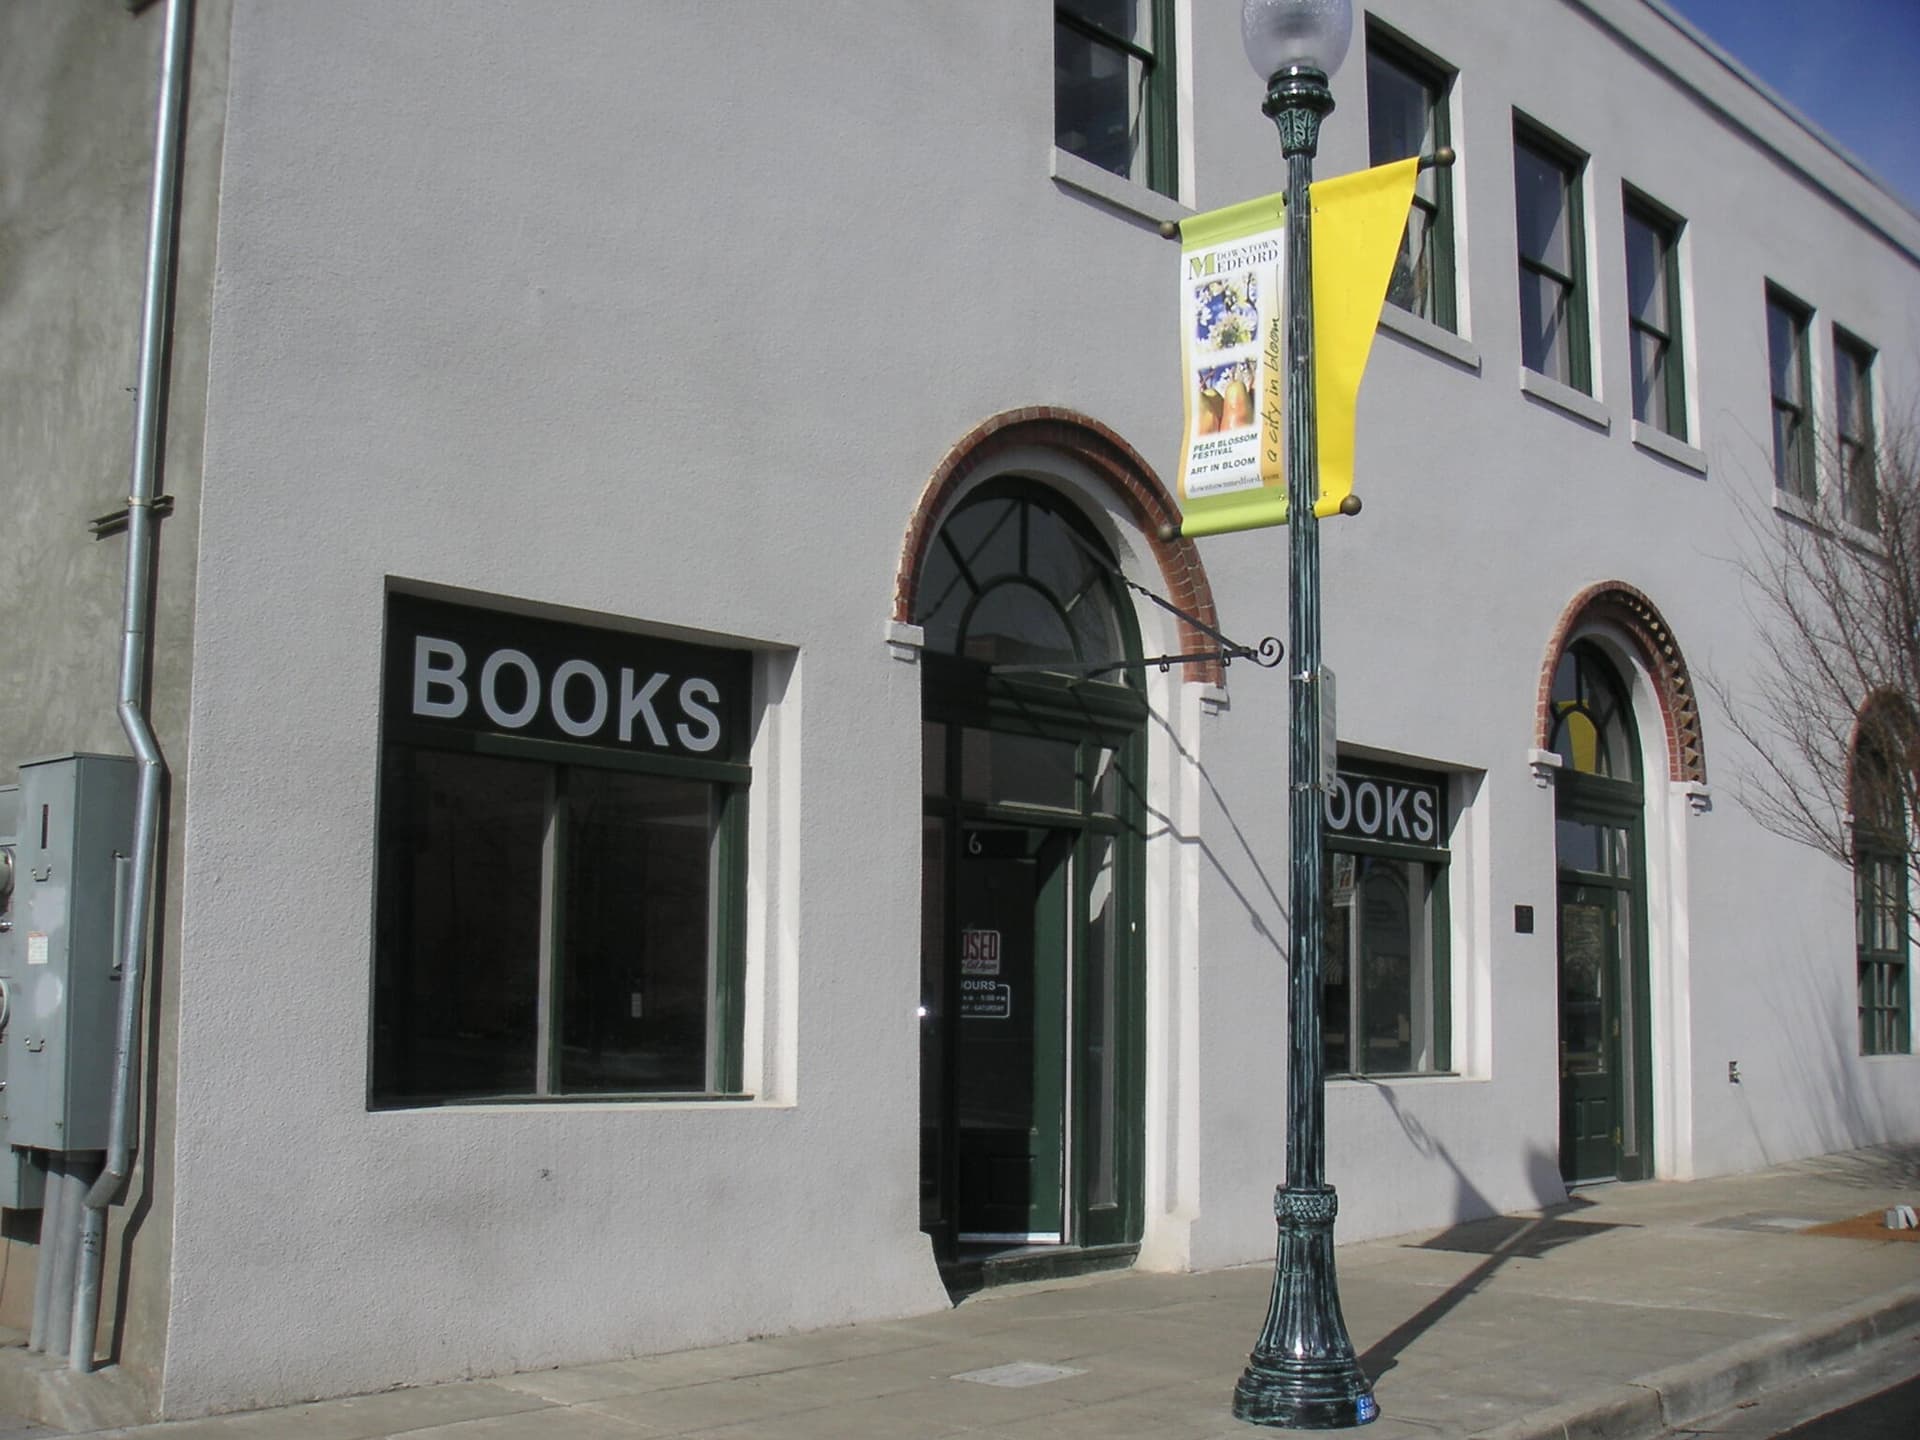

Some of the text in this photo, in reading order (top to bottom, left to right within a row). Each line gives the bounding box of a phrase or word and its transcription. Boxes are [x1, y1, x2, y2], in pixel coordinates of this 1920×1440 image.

[1217, 239, 1278, 261] DOWNTOWN
[1189, 249, 1278, 280] MEDFORD
[1265, 379, 1279, 396] in
[1260, 402, 1281, 444] city
[1192, 447, 1233, 460] FESTIVAL
[1193, 433, 1258, 453] PEAR BLOSSOM
[1190, 456, 1256, 475] ART IN BLOOM
[1266, 449, 1277, 463] a
[412, 634, 721, 753] BOOKS
[1324, 776, 1434, 842] OOKS
[968, 831, 982, 855] 6
[961, 931, 998, 961] OSED
[961, 979, 997, 991] OURS
